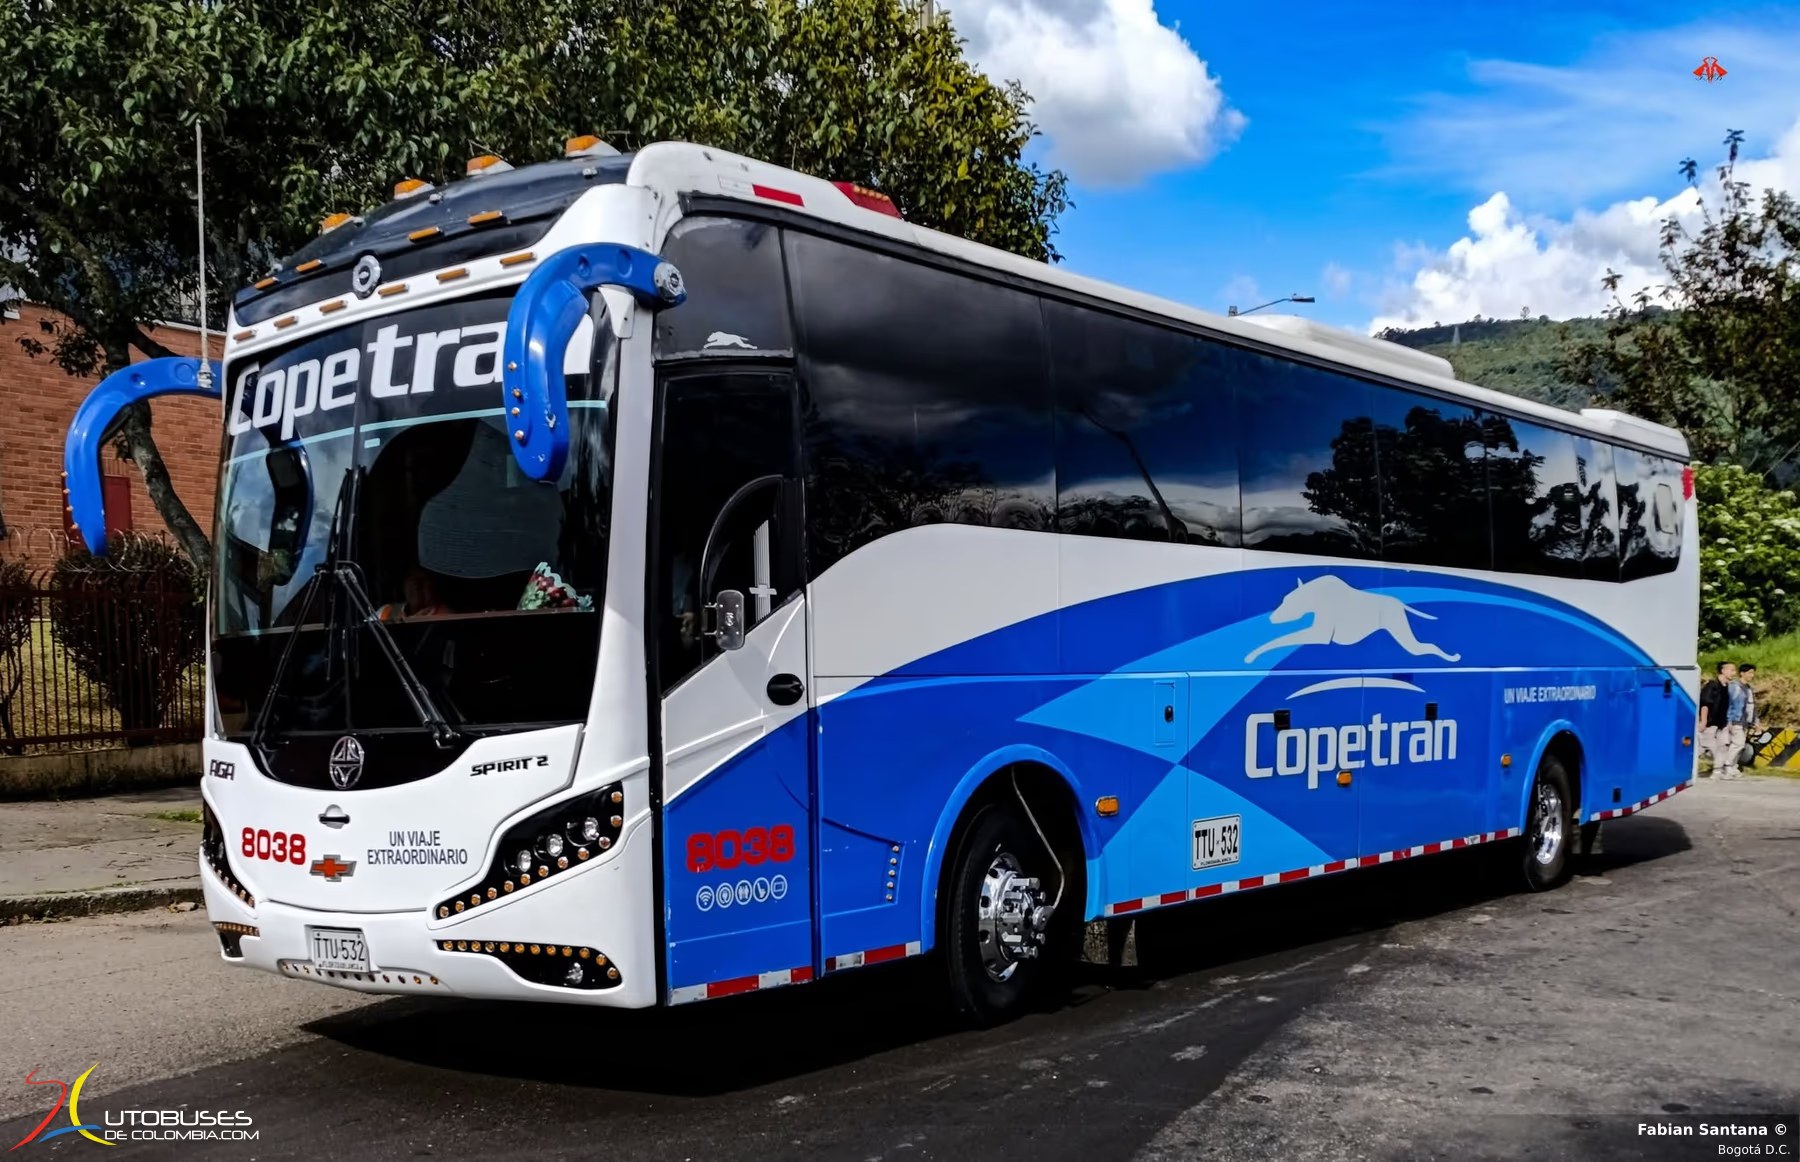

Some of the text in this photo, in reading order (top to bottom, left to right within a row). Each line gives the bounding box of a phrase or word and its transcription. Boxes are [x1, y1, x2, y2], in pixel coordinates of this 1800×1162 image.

[1504, 687, 1515, 704] UN
[1516, 687, 1537, 703] VIAJE
[1245, 713, 1457, 789] Copetran
[209, 759, 235, 781] AGA
[470, 755, 549, 777] SPIRIT 2
[241, 827, 307, 866] 8038
[389, 830, 441, 847] UN VIAJE
[686, 824, 795, 873] 8038
[367, 848, 468, 865] EXTRAORDINARIO
